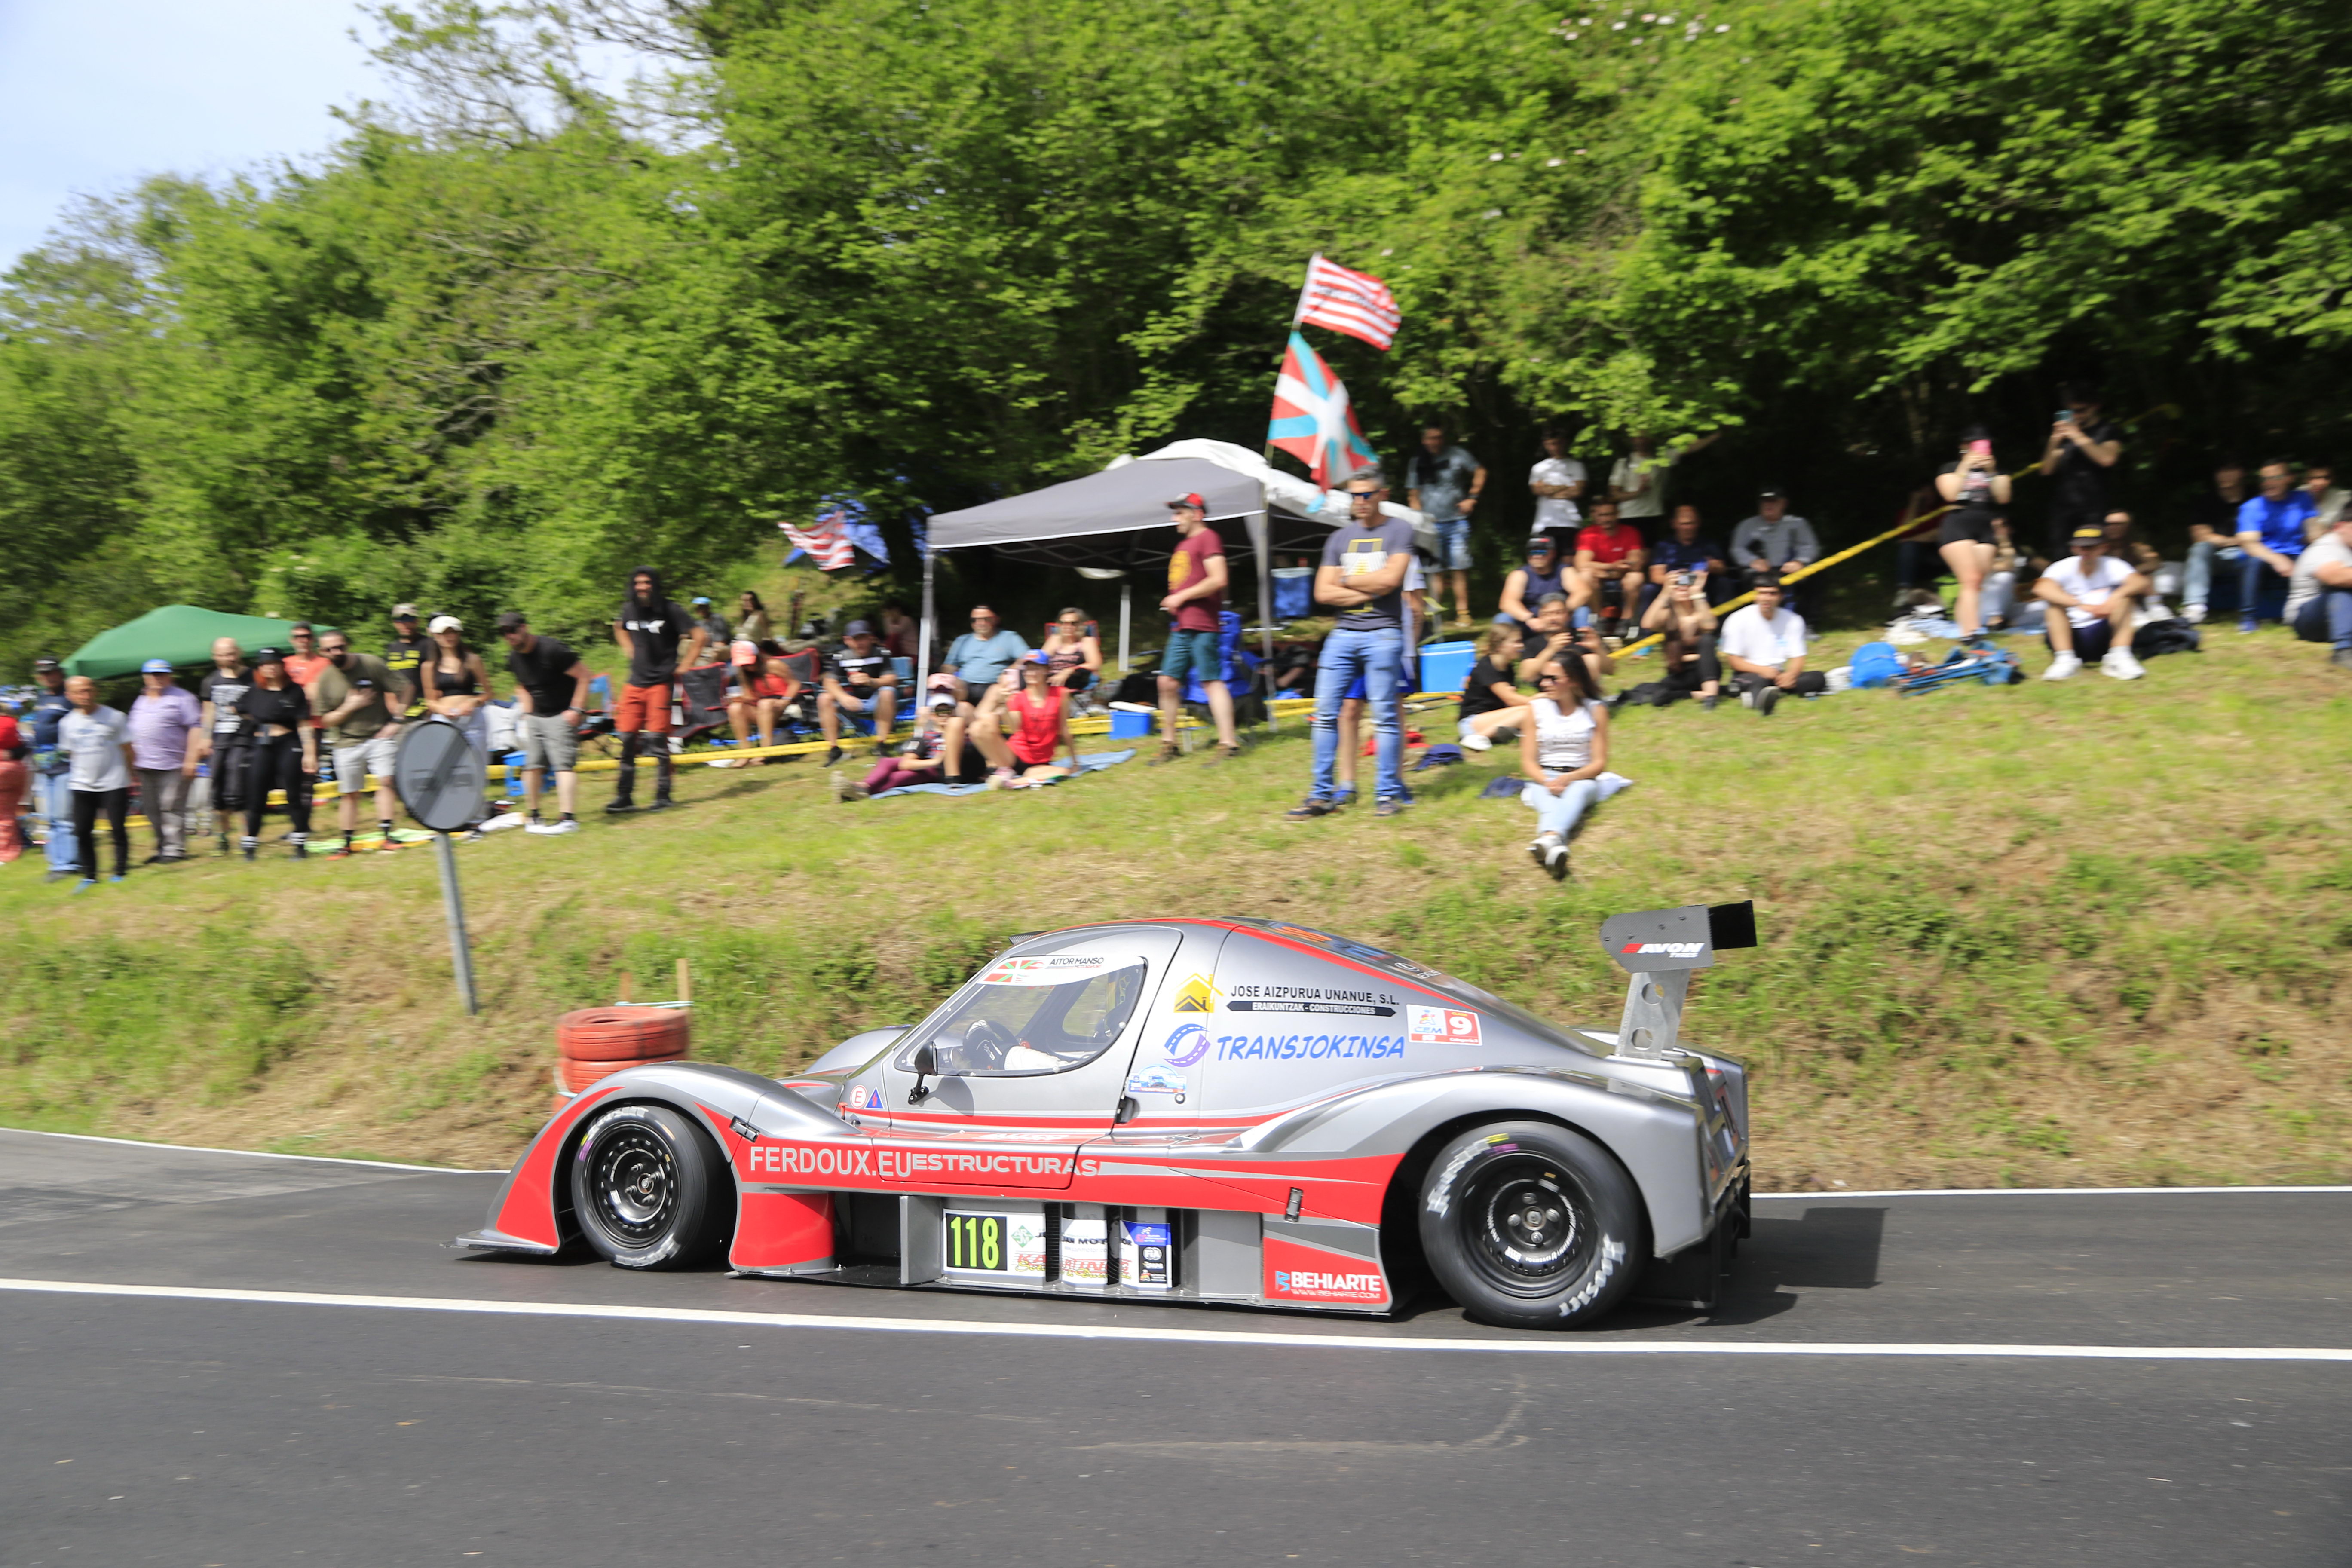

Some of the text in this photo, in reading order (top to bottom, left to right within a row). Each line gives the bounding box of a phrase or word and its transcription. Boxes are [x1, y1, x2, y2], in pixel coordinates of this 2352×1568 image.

[1637, 943, 1705, 953] AVON
[1231, 986, 1399, 1005] JOSE AIZPURUA UNANUE, S.L.
[1252, 1002, 1305, 1011] ERAIKUNTZAK
[1309, 1003, 1375, 1015] CONSTRUCCIONES
[1449, 1016, 1473, 1035] 9
[1217, 1035, 1405, 1061] TRANSJOKINSA
[854, 1090, 863, 1103] E
[750, 1146, 1098, 1177] FERDOUX.EU ESTRUCTURAS
[950, 1216, 1000, 1269] 118
[1291, 1271, 1381, 1291] BEHIARTE
